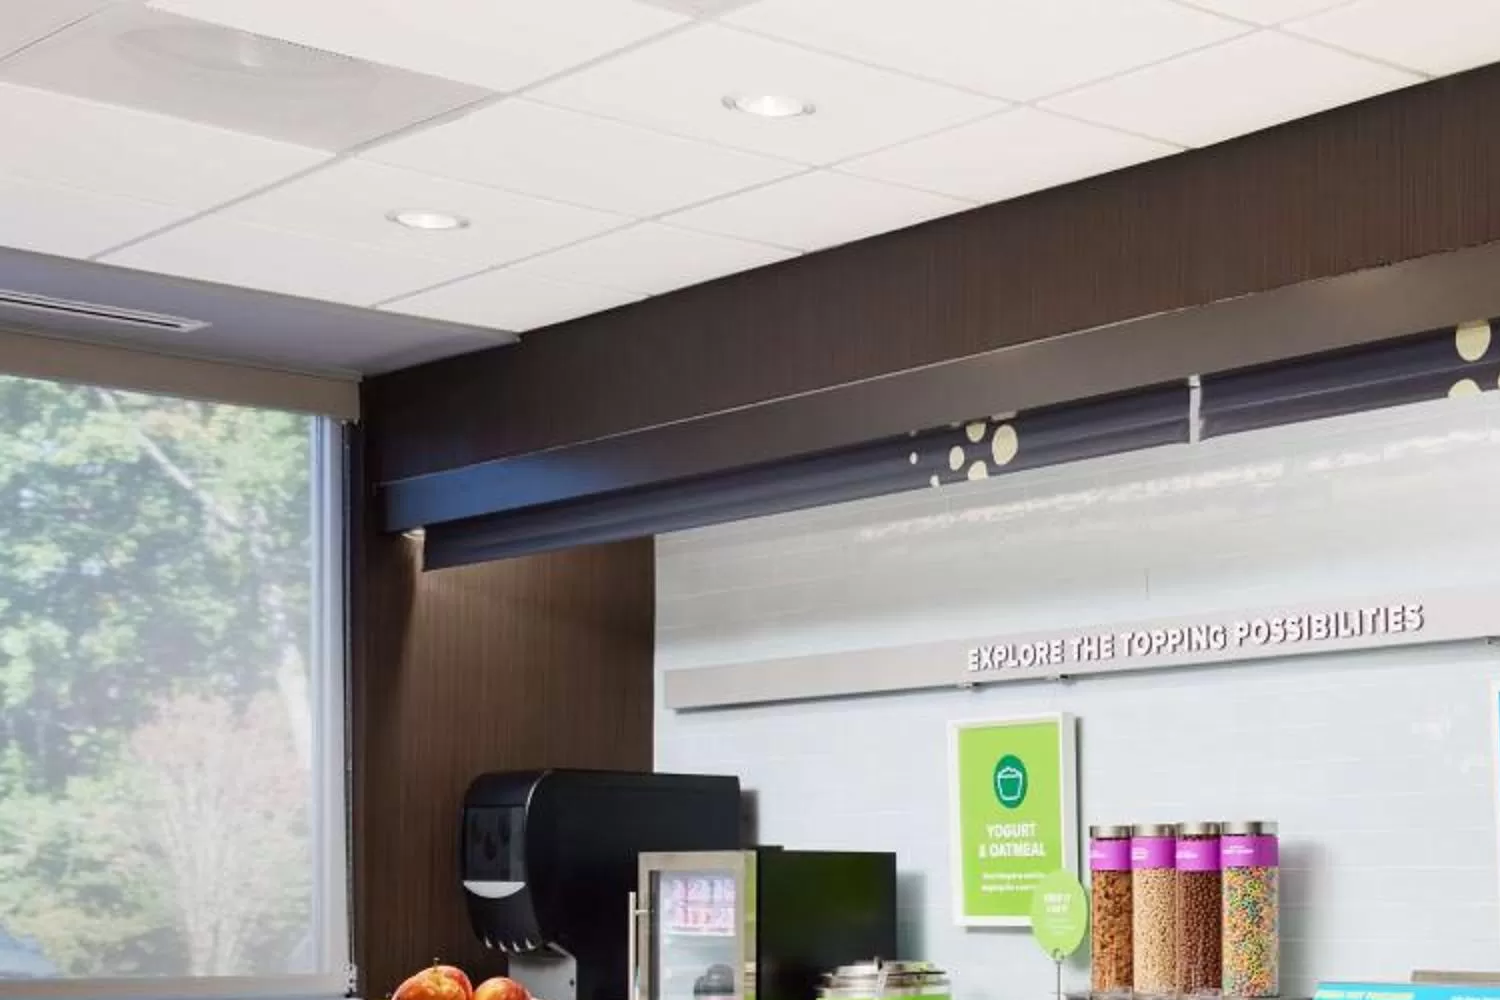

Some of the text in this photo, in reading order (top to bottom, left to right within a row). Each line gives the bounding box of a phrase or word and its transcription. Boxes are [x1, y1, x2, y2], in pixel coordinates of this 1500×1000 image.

[968, 604, 1424, 671] EXPLORE THE TOPPING POSSIBILITIES
[985, 822, 1037, 838] YOGURT
[989, 841, 1047, 857] OATMEAL
